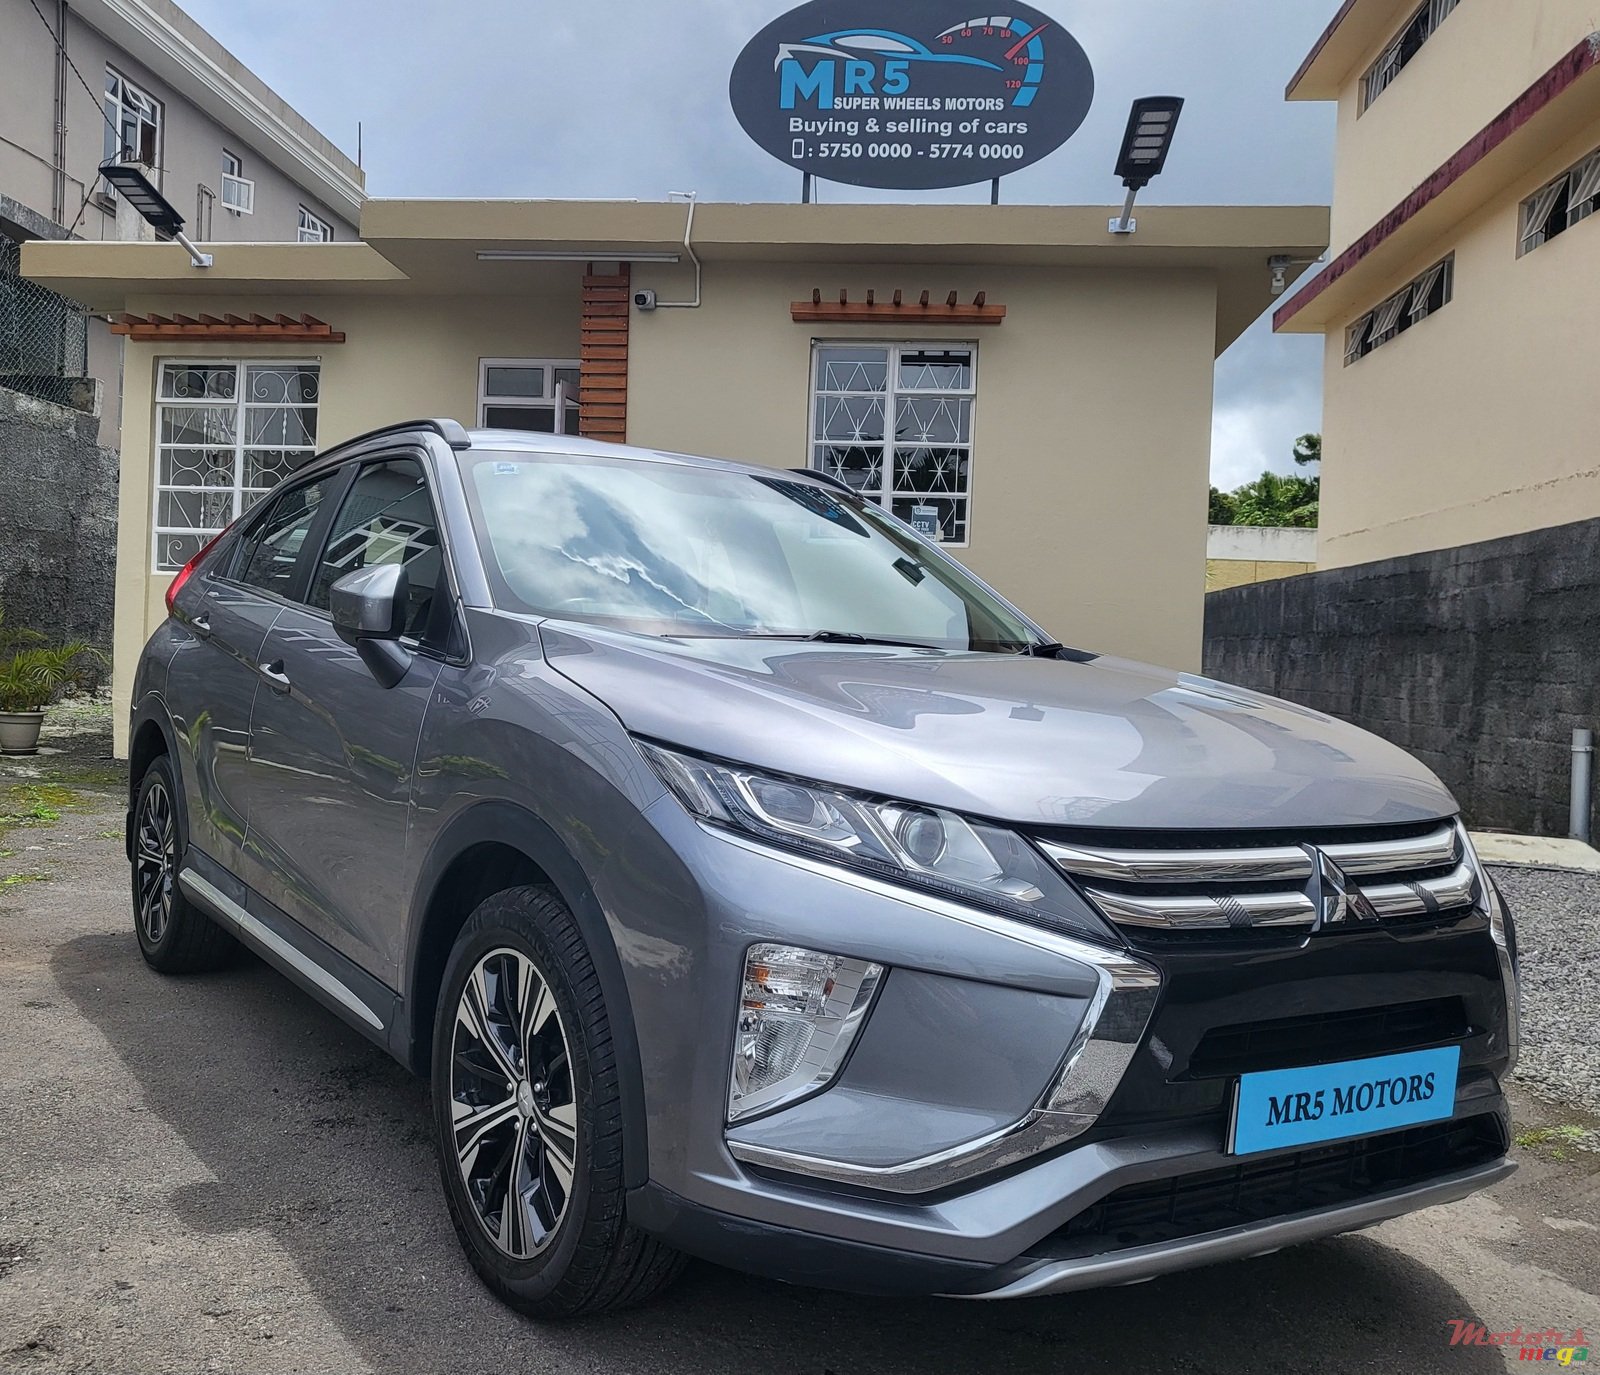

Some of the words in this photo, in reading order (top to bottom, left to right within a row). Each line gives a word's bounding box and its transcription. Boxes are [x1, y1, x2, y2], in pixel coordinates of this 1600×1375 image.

[942, 35, 953, 44] 50
[961, 28, 972, 37] 60
[983, 27, 993, 35] 70
[1000, 30, 1011, 38] 80
[1014, 57, 1029, 65] 100
[780, 59, 910, 109] MR5
[1005, 80, 1021, 88] 120
[834, 97, 880, 110] SUPER
[884, 97, 941, 111] WHEELS
[945, 98, 1004, 111] MOTORS
[789, 117, 859, 135] Buying
[865, 118, 880, 133] &
[886, 118, 952, 136] selling
[959, 118, 979, 134] of
[984, 121, 1028, 134] cars
[818, 143, 863, 158] 5750
[868, 143, 912, 158] 0000
[929, 144, 973, 159] 5774
[979, 144, 1024, 159] 0000
[1265, 1090, 1325, 1126] MR5
[1330, 1072, 1435, 1116] MOTORS
